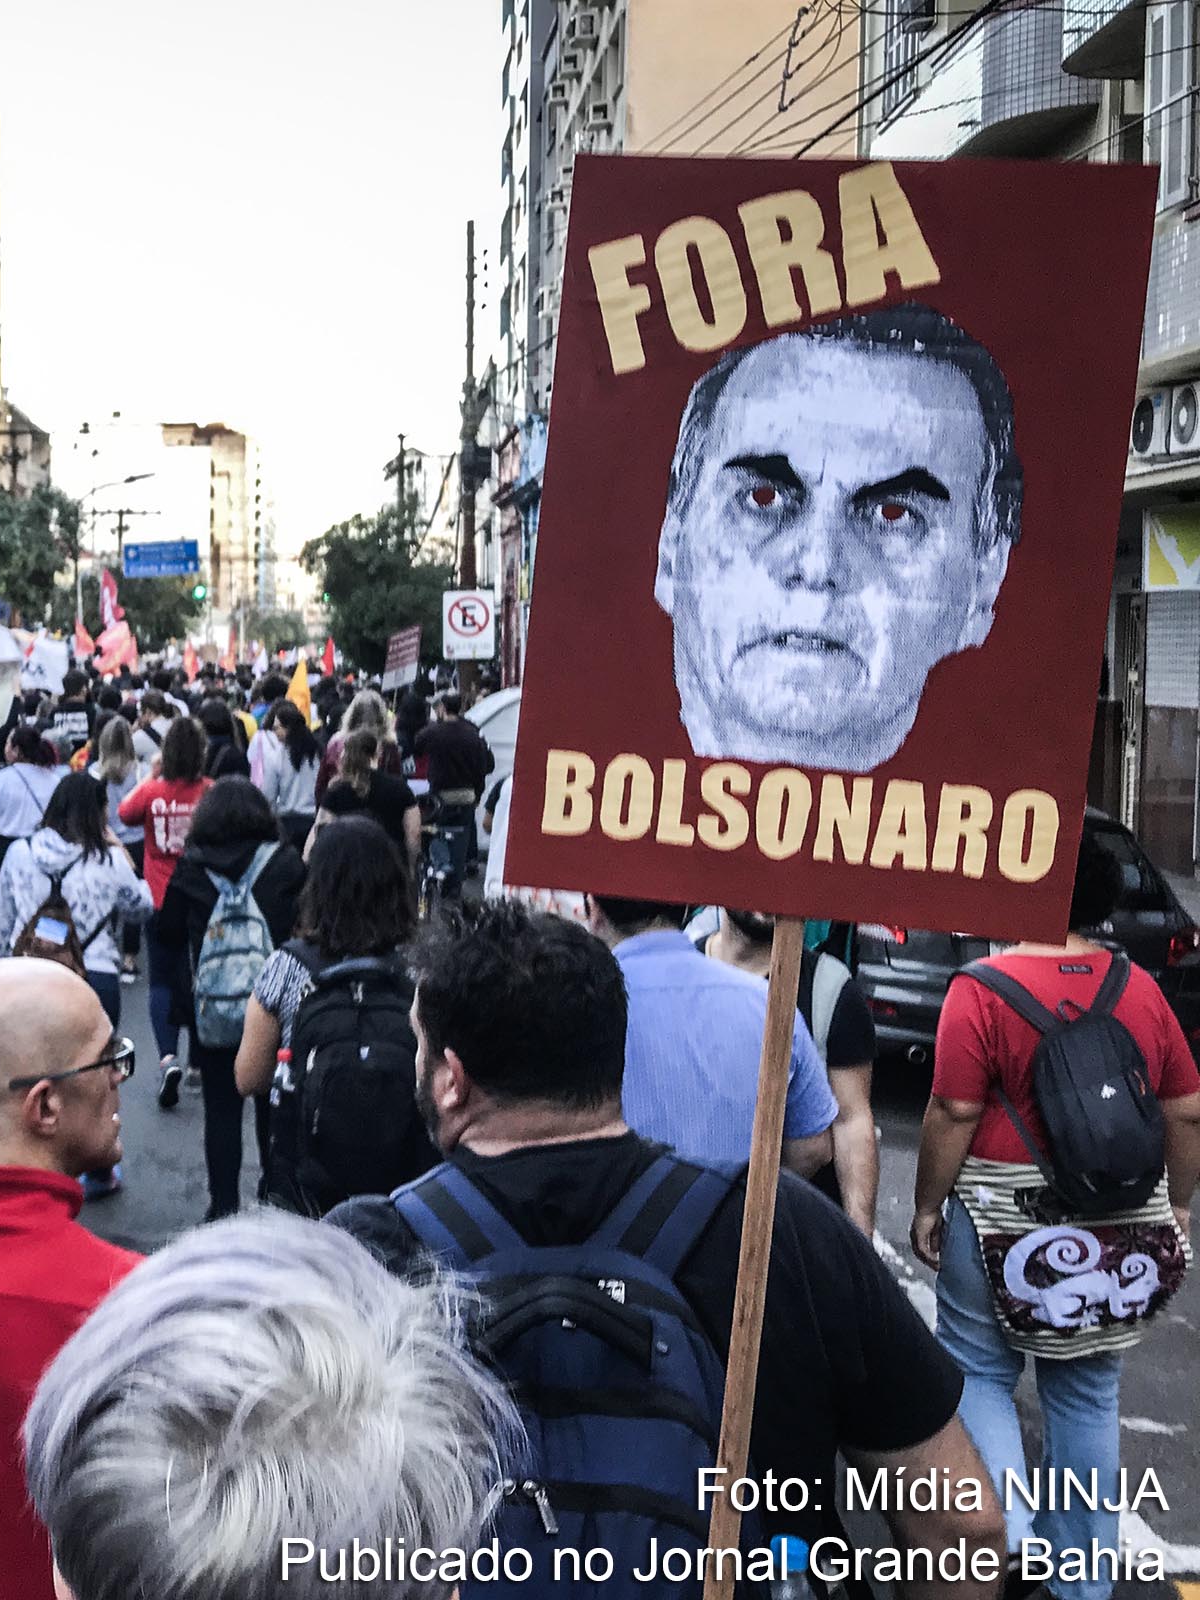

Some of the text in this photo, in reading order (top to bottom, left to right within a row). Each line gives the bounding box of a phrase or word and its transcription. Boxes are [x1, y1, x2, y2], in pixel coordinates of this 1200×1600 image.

[588, 161, 941, 376] FORA
[462, 606, 477, 627] E
[541, 749, 1060, 883] BOLSONARO
